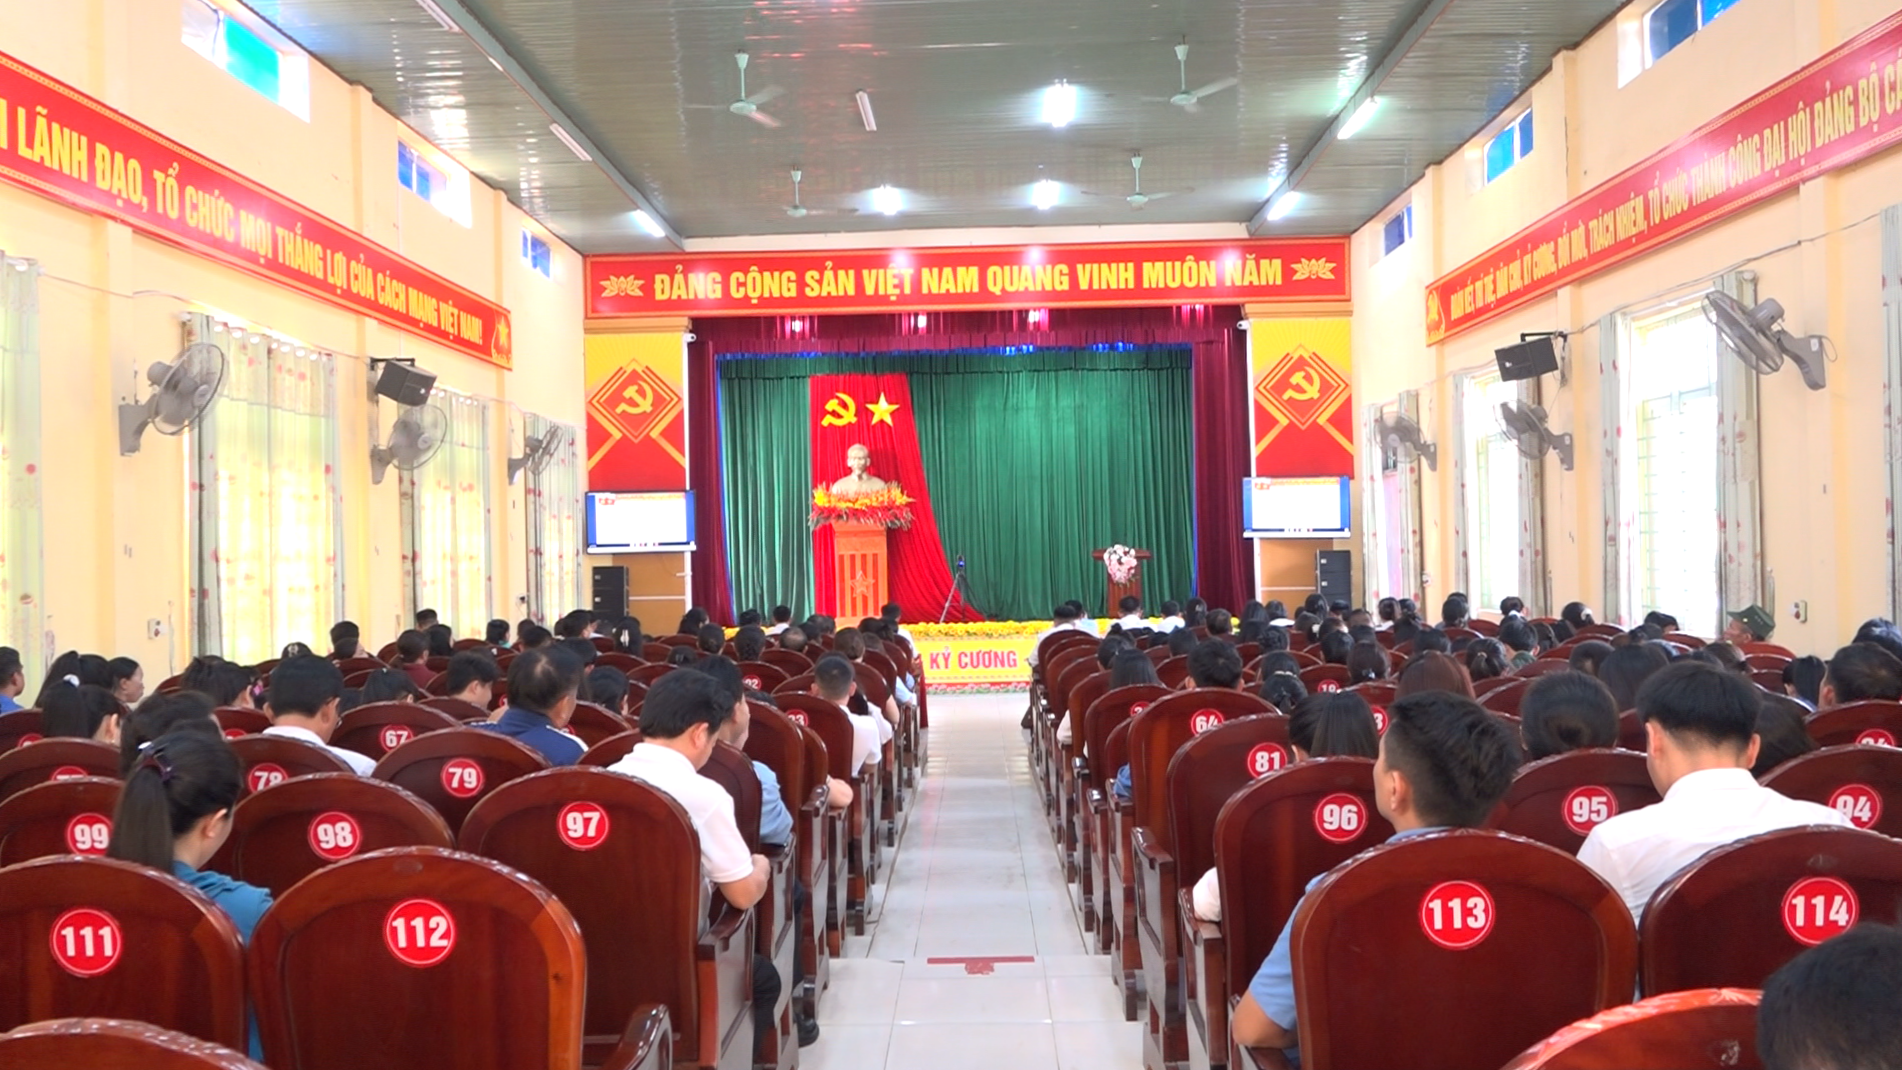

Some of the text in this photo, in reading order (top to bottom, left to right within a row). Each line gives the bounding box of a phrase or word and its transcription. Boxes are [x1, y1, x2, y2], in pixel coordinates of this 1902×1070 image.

[1589, 209, 1615, 255] TRÁCH
[1616, 191, 1648, 243] NHIỆM,
[1648, 171, 1660, 227] TỔ
[1662, 167, 1689, 221] CHỨC
[1691, 152, 1726, 206] THÀNH
[1728, 134, 1761, 189] CÔNG
[1763, 121, 1785, 178] ĐẠI
[1788, 101, 1811, 166] HỘI
[1814, 80, 1855, 149] ĐẢNG
[1858, 62, 1880, 133] BỘ
[17, 105, 88, 183] LÃNH
[95, 142, 148, 213] ĐẠO,
[153, 161, 180, 220] TỔ
[184, 185, 234, 243] CHỨC
[239, 209, 273, 265] MỌI
[275, 222, 324, 280] THẮNG
[327, 249, 347, 295] LỢI
[350, 253, 375, 301] CỦA
[377, 270, 406, 314] CÁCH
[408, 286, 438, 328] MẠNG
[439, 300, 459, 340] VIỆT
[460, 310, 483, 345] NAM!
[654, 253, 1282, 304] ĐẢNG CỘNG SẢN VIỆT NAM QUANG VINH MUÔN NĂM
[930, 646, 1017, 669] KỶ CƯƠNG
[1196, 717, 1219, 732] 64
[385, 731, 408, 747] 67
[1255, 752, 1280, 770] 81
[254, 771, 283, 790] 78
[448, 767, 477, 788] 79
[1324, 804, 1357, 830] 96
[1573, 797, 1607, 822] 95
[1835, 796, 1871, 822] 94
[75, 824, 108, 849] 99
[318, 822, 352, 848] 98
[567, 812, 600, 837] 97
[1429, 898, 1486, 929] 113
[1791, 896, 1849, 926] 114
[61, 926, 113, 957] 111
[392, 916, 448, 948] 112
